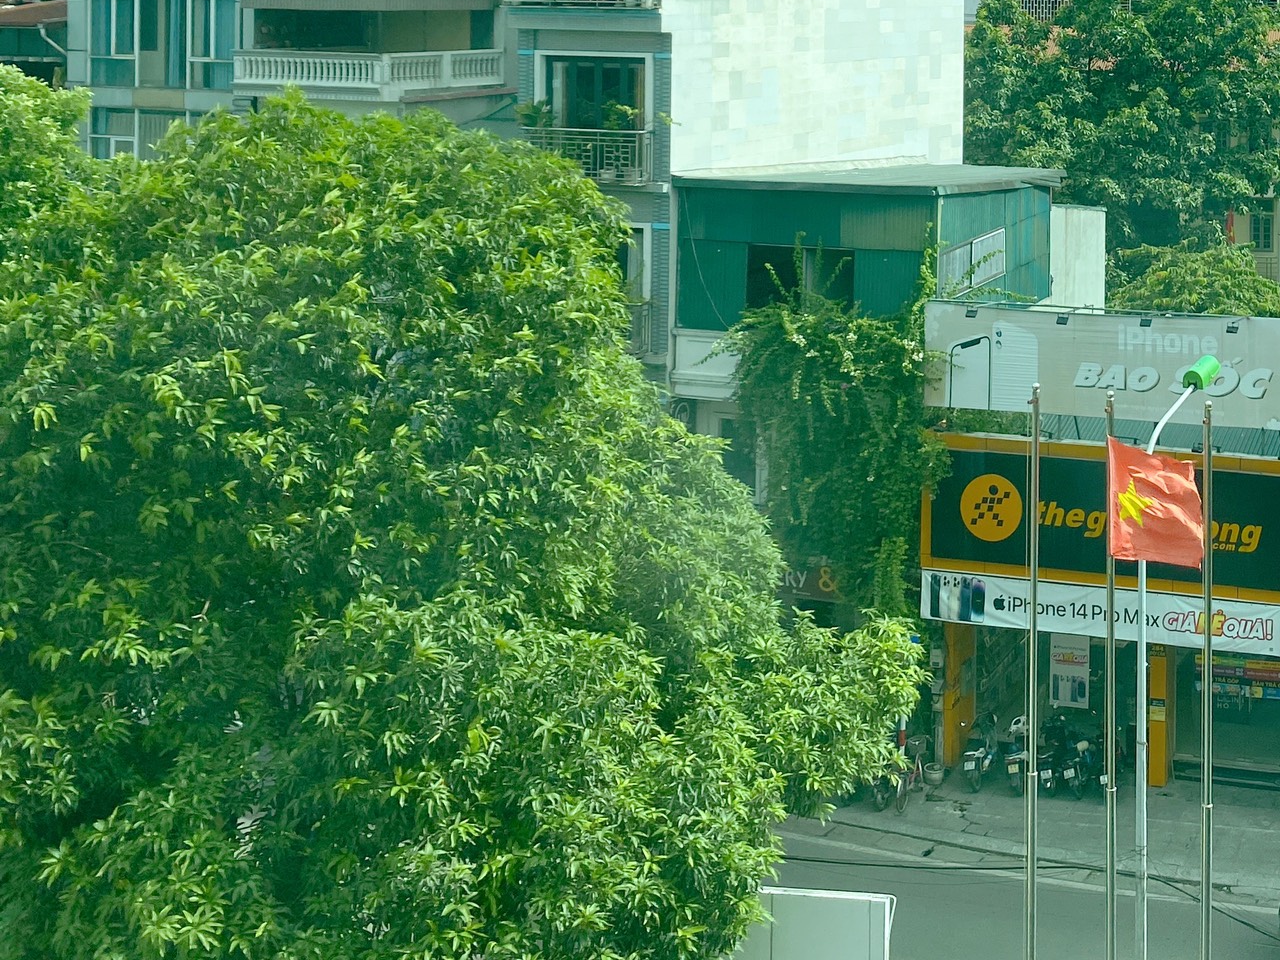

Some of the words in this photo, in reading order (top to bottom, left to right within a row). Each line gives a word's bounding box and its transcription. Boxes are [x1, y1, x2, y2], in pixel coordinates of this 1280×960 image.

[1118, 324, 1218, 354] iPhone
[1074, 362, 1160, 392] BAO
[1212, 543, 1235, 551] com
[1007, 596, 1066, 617] iPhone
[1070, 602, 1088, 619] 14
[1162, 611, 1196, 633] GIÁ
